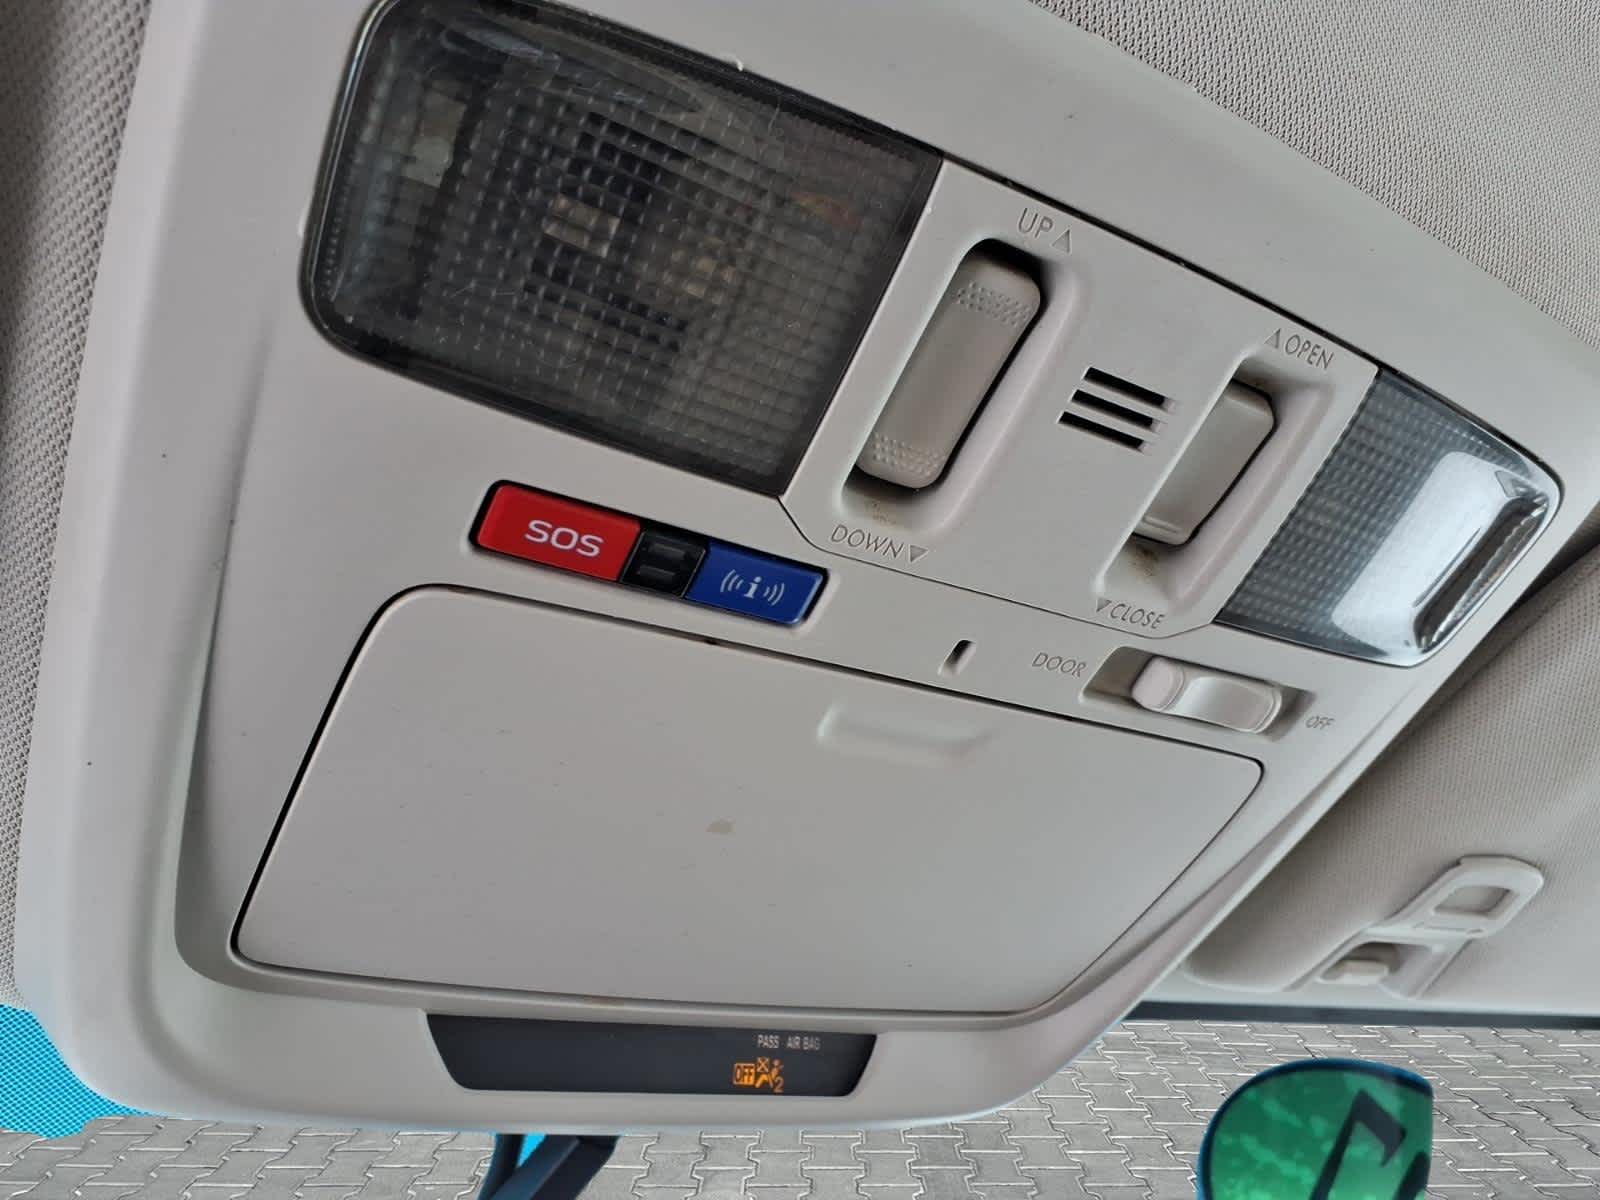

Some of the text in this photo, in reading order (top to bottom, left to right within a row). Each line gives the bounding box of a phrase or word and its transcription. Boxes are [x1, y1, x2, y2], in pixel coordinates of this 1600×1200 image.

[1018, 207, 1054, 239] UP
[1285, 334, 1335, 370] OPEN
[524, 519, 605, 558] SOS
[831, 524, 904, 558] DOWN
[1110, 603, 1165, 629] CLOSE
[1031, 652, 1087, 678] DOOR
[1305, 715, 1335, 730] OFF
[757, 1034, 780, 1049] PASS
